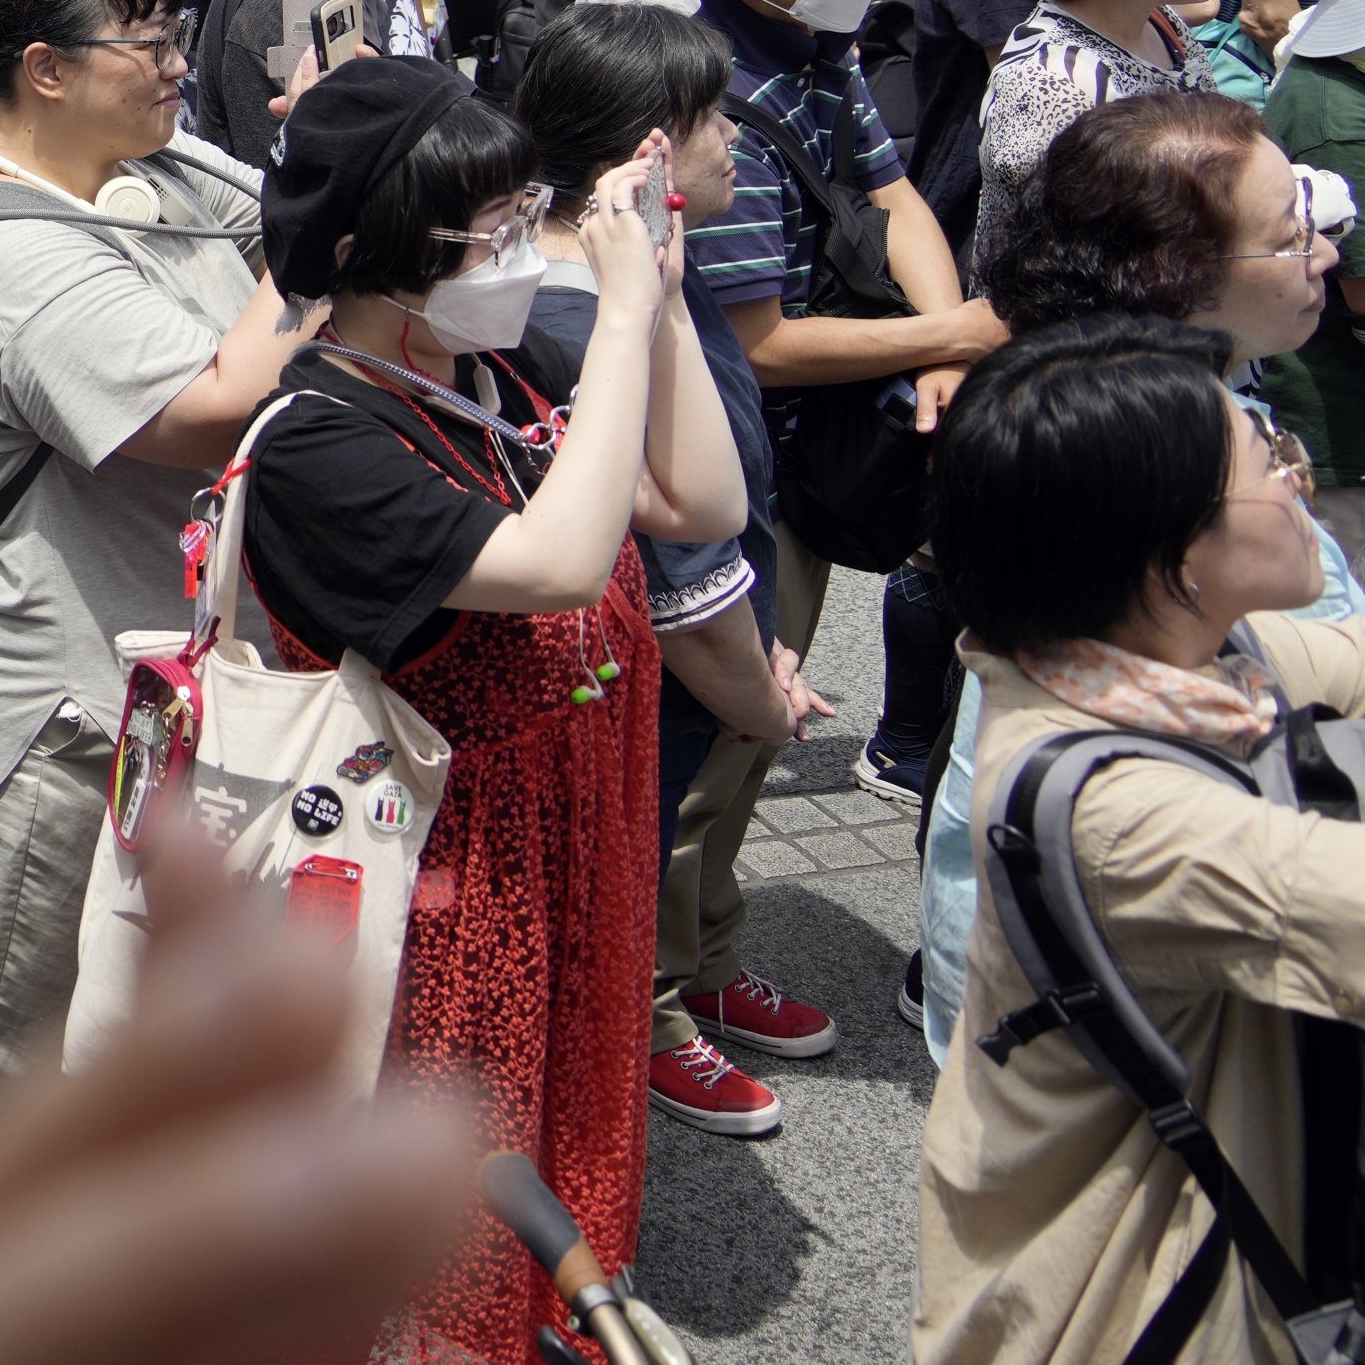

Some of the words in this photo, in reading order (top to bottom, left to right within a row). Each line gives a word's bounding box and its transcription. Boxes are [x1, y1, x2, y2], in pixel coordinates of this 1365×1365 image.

[385, 784, 402, 792] SAVE
[300, 790, 316, 803] NO
[383, 790, 403, 798] GAZA
[296, 800, 312, 813] NO
[313, 807, 339, 826] LIFE
